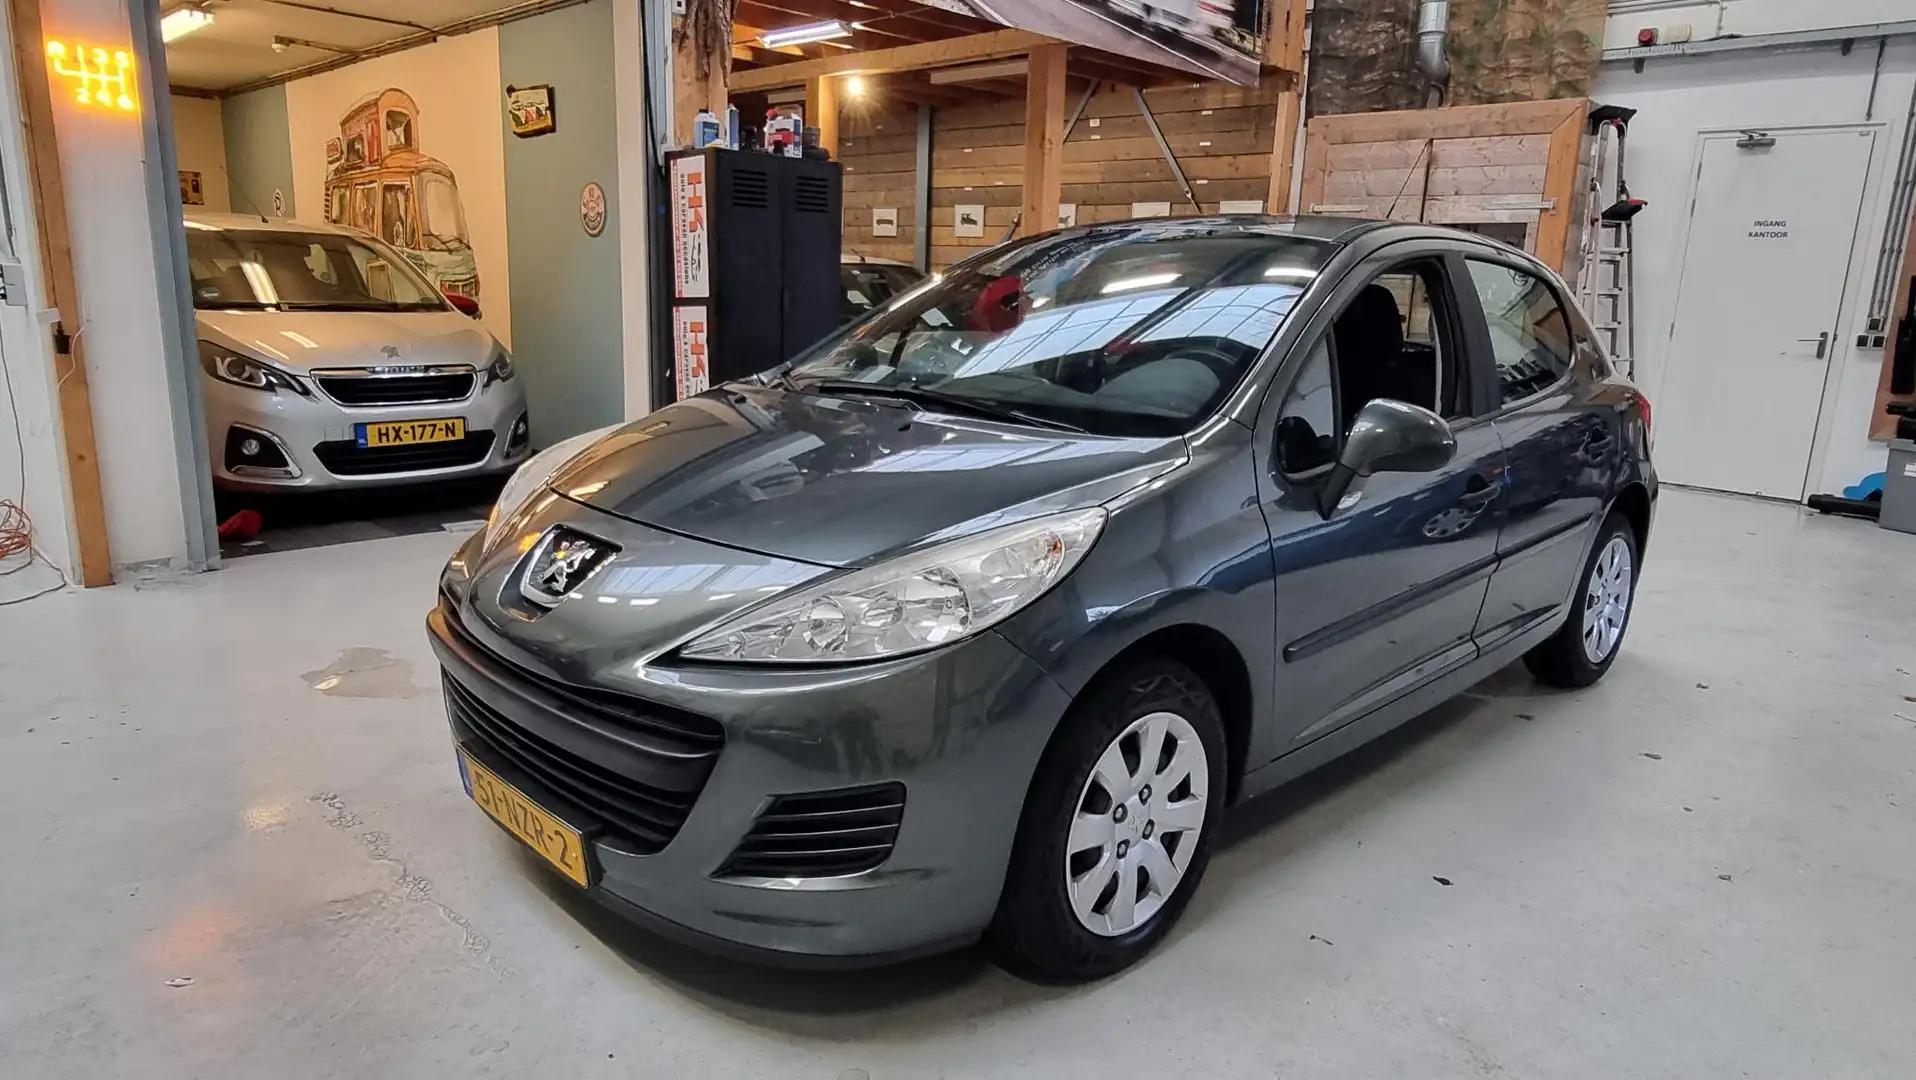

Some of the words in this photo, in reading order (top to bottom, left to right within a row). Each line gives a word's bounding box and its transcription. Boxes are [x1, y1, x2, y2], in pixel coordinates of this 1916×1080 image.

[76, 87, 92, 105] 2
[686, 172, 704, 233] HK
[1753, 220, 1787, 228] INGANG
[1748, 231, 1789, 239] KANTOOR
[376, 421, 457, 443] HX-177-N
[473, 769, 574, 871] 51-NZR-2
